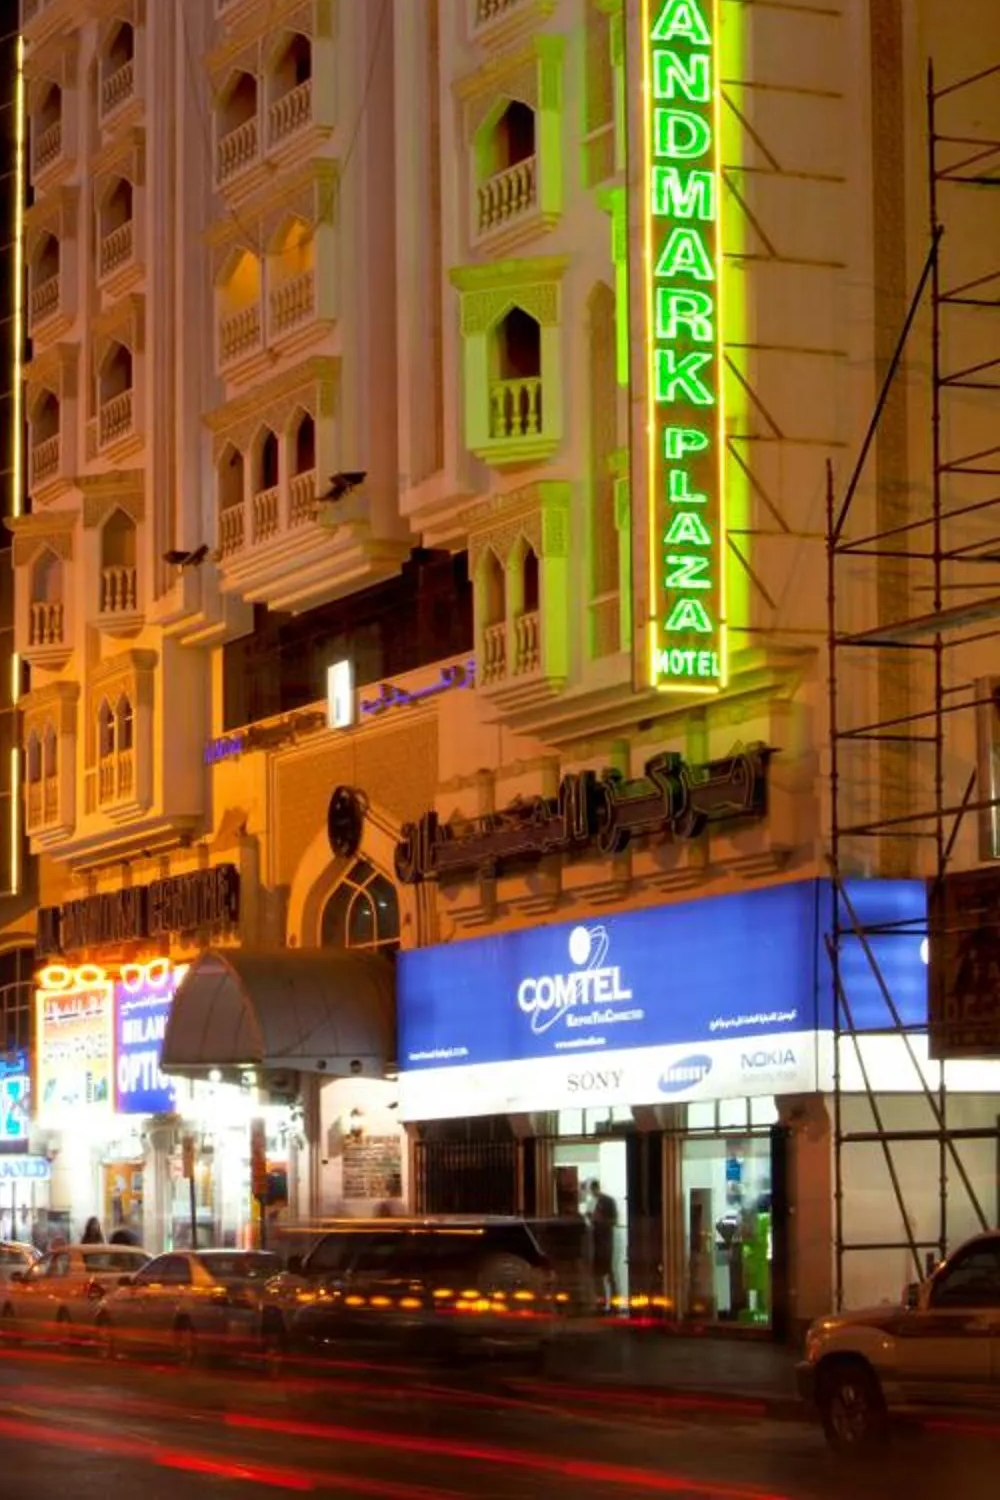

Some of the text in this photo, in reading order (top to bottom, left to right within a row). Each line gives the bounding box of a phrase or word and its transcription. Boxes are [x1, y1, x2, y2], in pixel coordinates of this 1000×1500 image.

[664, 426, 713, 634] PLAZA
[655, 647, 721, 677] HOTEL
[518, 966, 632, 1012] COMTEL
[741, 1048, 797, 1070] NOKIA
[566, 1069, 626, 1093] SONY
